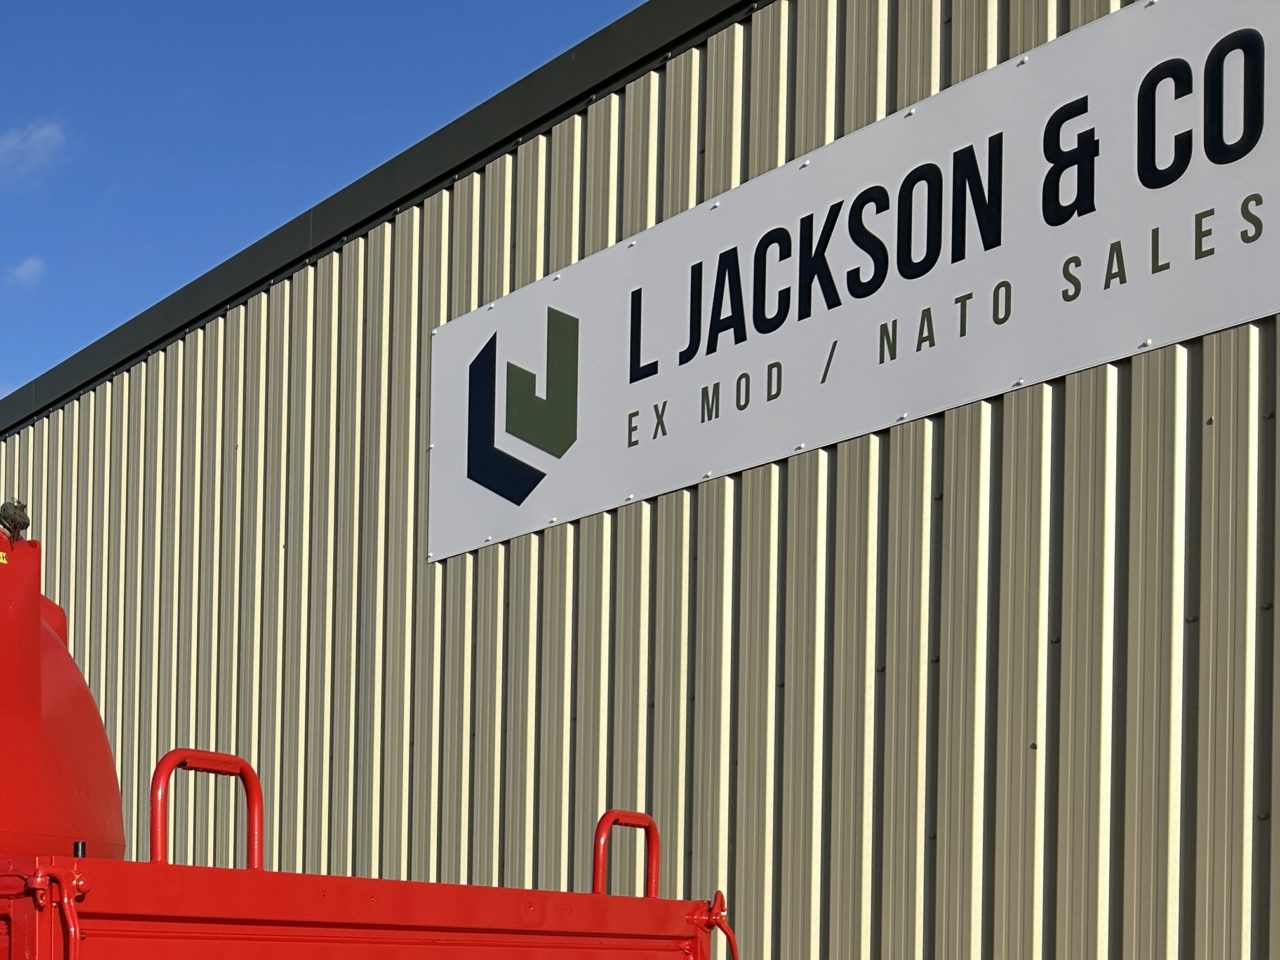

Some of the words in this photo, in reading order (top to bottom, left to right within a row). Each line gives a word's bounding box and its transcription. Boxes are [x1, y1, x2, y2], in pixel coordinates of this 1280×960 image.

[628, 401, 667, 448] EX
[701, 362, 782, 423] MOD
[821, 340, 838, 384] /
[879, 281, 1012, 364] NATO
[1062, 194, 1264, 302] SALES
[629, 288, 658, 384] L
[679, 132, 1004, 366] JACKSON
[1042, 95, 1100, 226] &
[1137, 28, 1265, 189] CO
